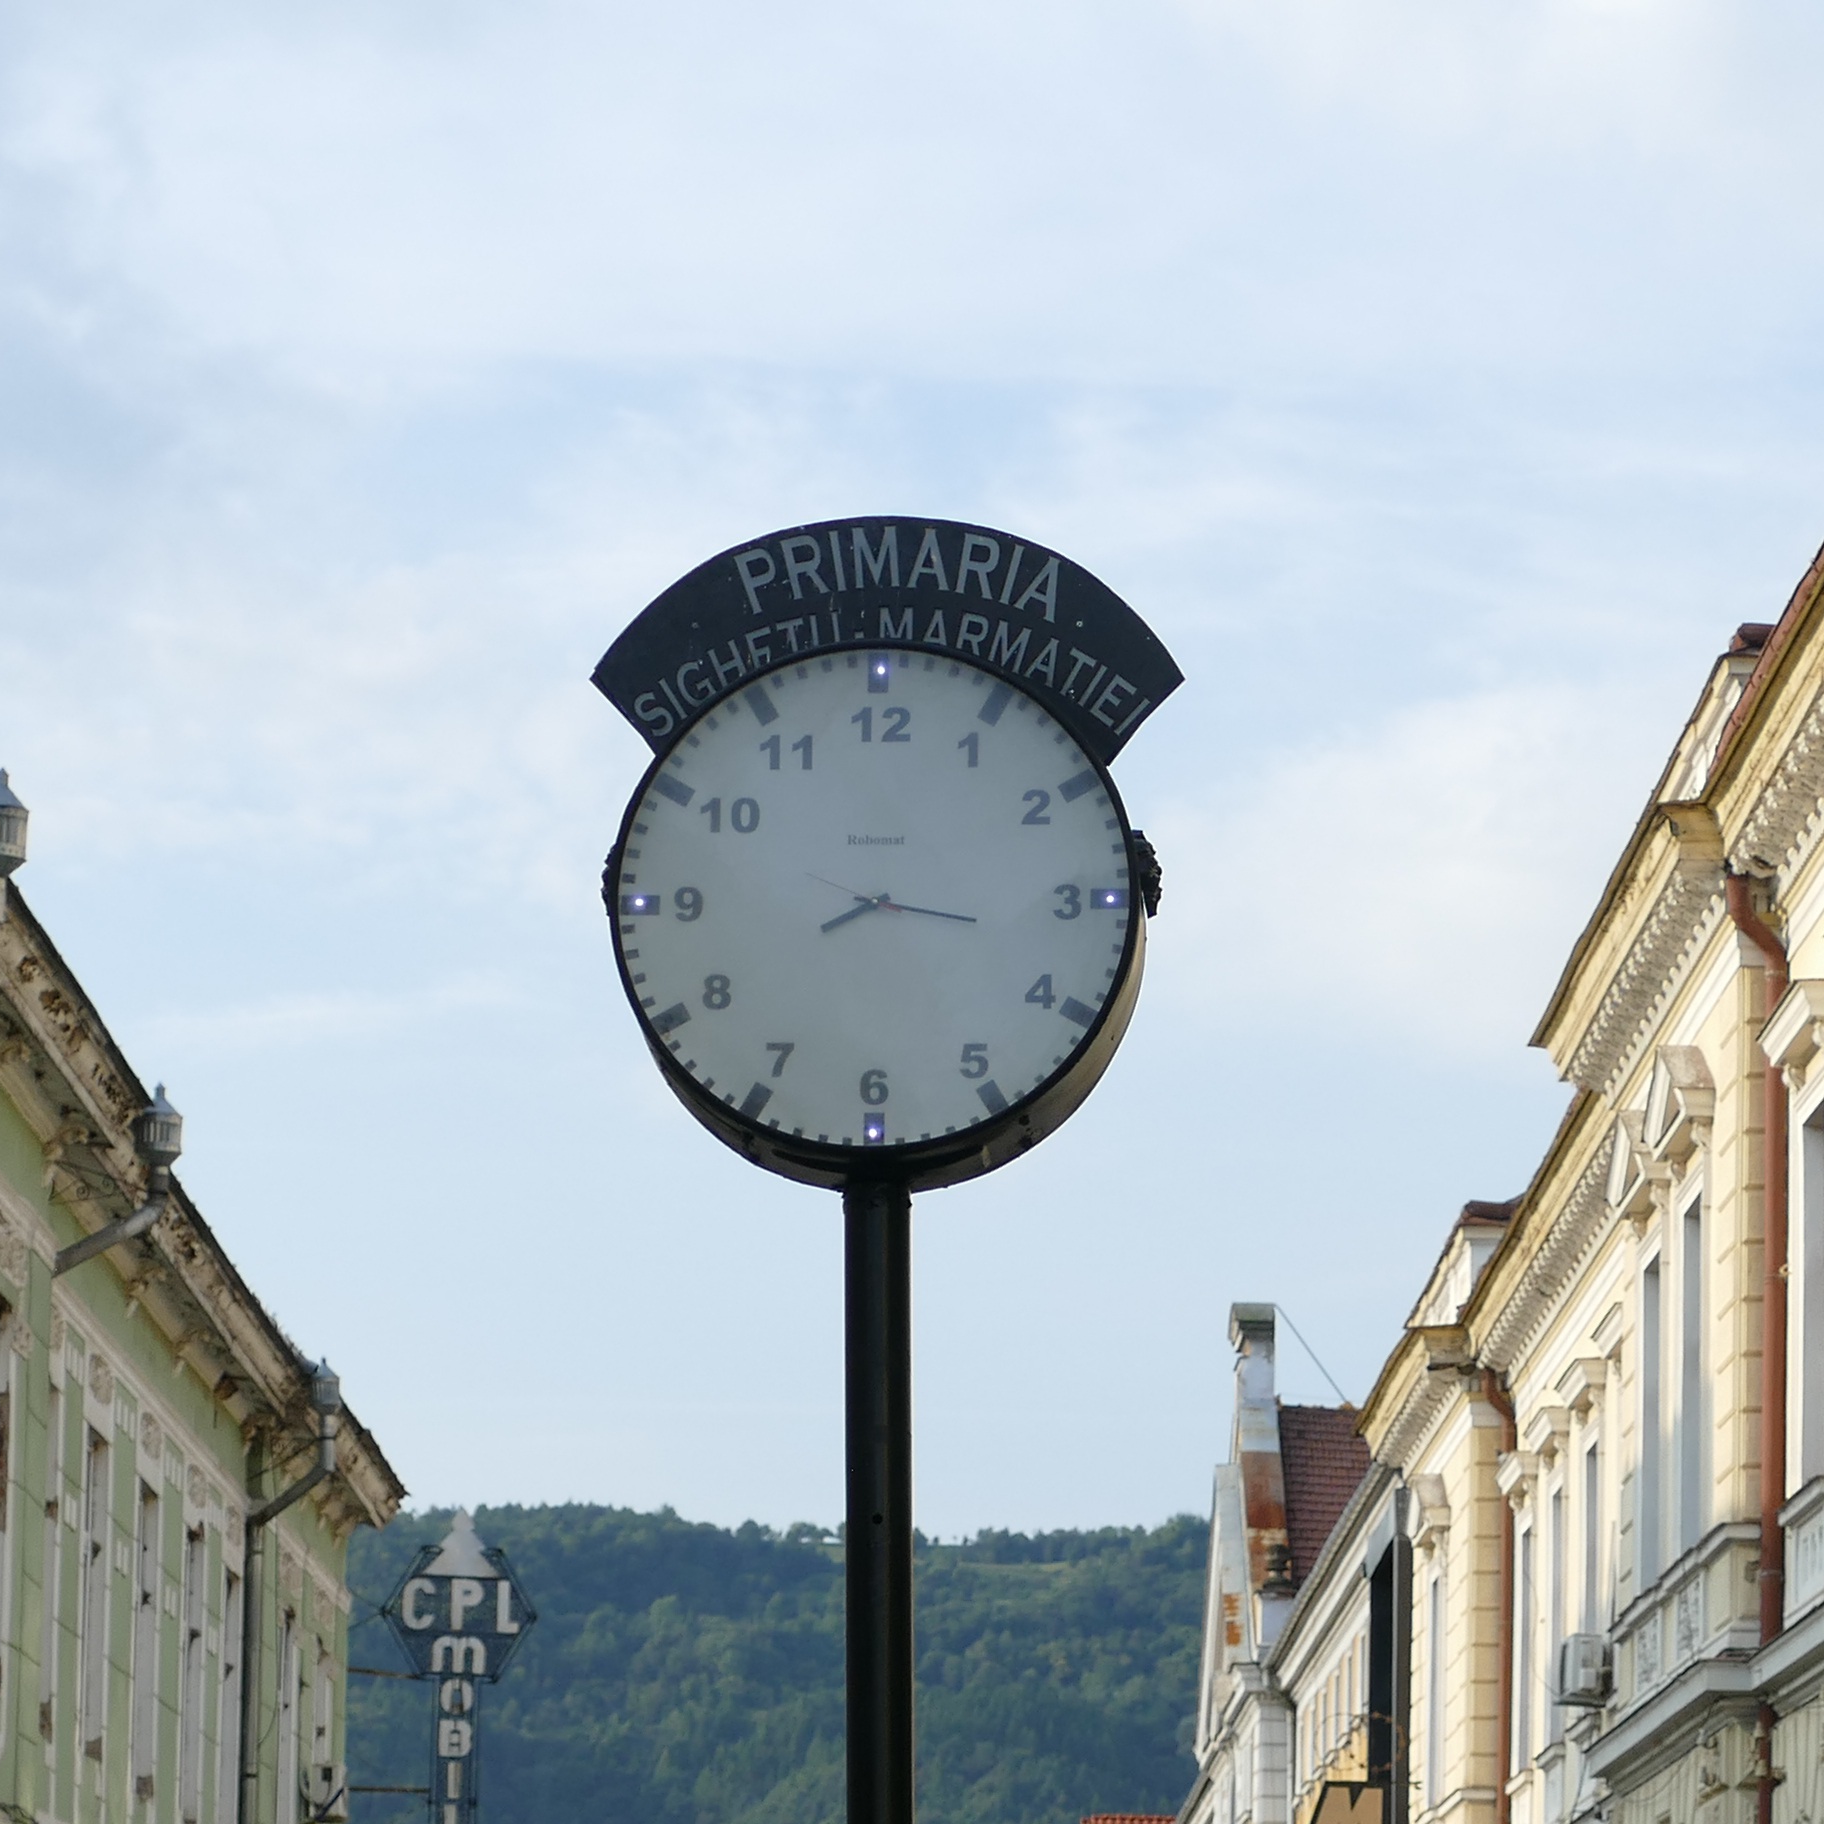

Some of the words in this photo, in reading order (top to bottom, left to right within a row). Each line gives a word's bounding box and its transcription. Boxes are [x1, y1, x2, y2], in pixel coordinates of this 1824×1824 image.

[732, 524, 1062, 624] PRIMARIA
[878, 606, 1151, 737] MARMATIEI
[851, 706, 912, 744] 12
[759, 734, 814, 771] 11
[956, 732, 978, 768] 1
[700, 797, 760, 834] 10
[1021, 789, 1052, 826] 2
[846, 832, 906, 847] Robomat
[674, 886, 704, 923] 9
[1052, 883, 1083, 919] 3
[702, 974, 732, 1010] 8
[1024, 974, 1056, 1010] 4
[766, 1041, 795, 1078] 7
[959, 1042, 989, 1078] 5
[859, 1068, 890, 1105] 6
[401, 1577, 520, 1635] CPL
